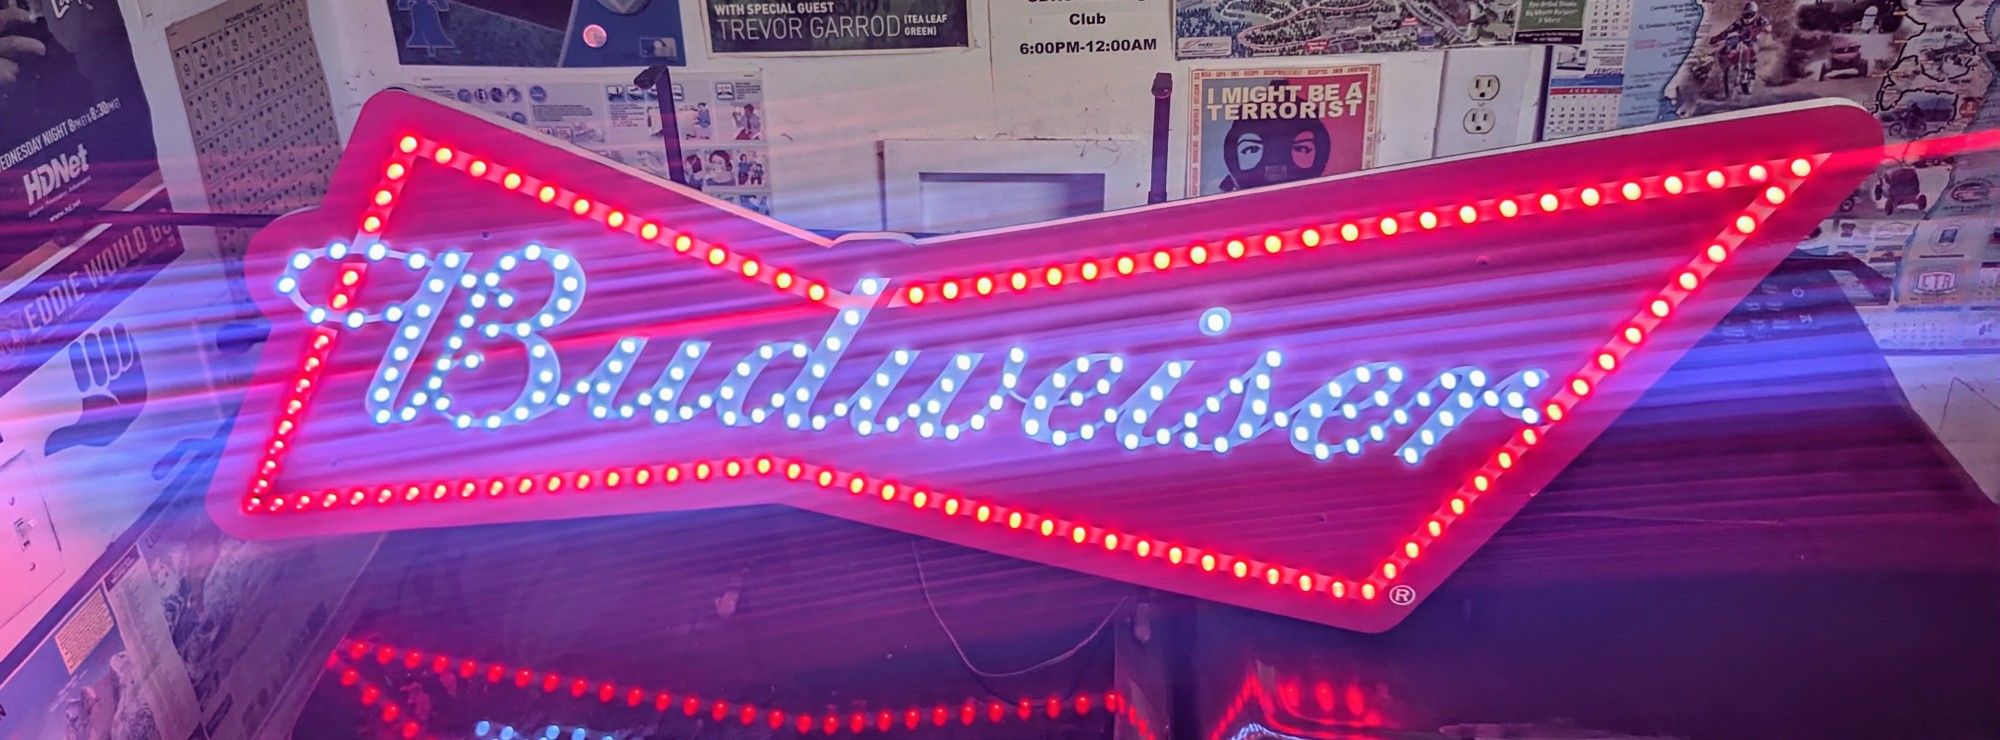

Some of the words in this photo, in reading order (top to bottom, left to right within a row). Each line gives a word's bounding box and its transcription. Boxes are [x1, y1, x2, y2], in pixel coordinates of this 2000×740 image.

[713, 4, 744, 16] WITH
[746, 2, 795, 15] SPECIAL
[797, 1, 835, 13] GUEST
[1069, 13, 1106, 25] Club
[716, 18, 803, 40] TREVOR
[809, 15, 900, 39] GARROD
[925, 14, 948, 23] LEAF
[1019, 38, 1157, 54] 6:00PM-12:00AM
[1207, 88, 1214, 104] I
[1222, 85, 1302, 105] MIGHT
[1308, 84, 1340, 102] BE
[1344, 81, 1363, 100] A
[1206, 99, 1363, 121] TERRORIST
[42, 121, 69, 147] NIGHT
[22, 143, 90, 206] HDNet
[24, 271, 85, 334] EDDIE
[84, 225, 148, 288] WOULD
[277, 242, 1550, 464] Budweiser
